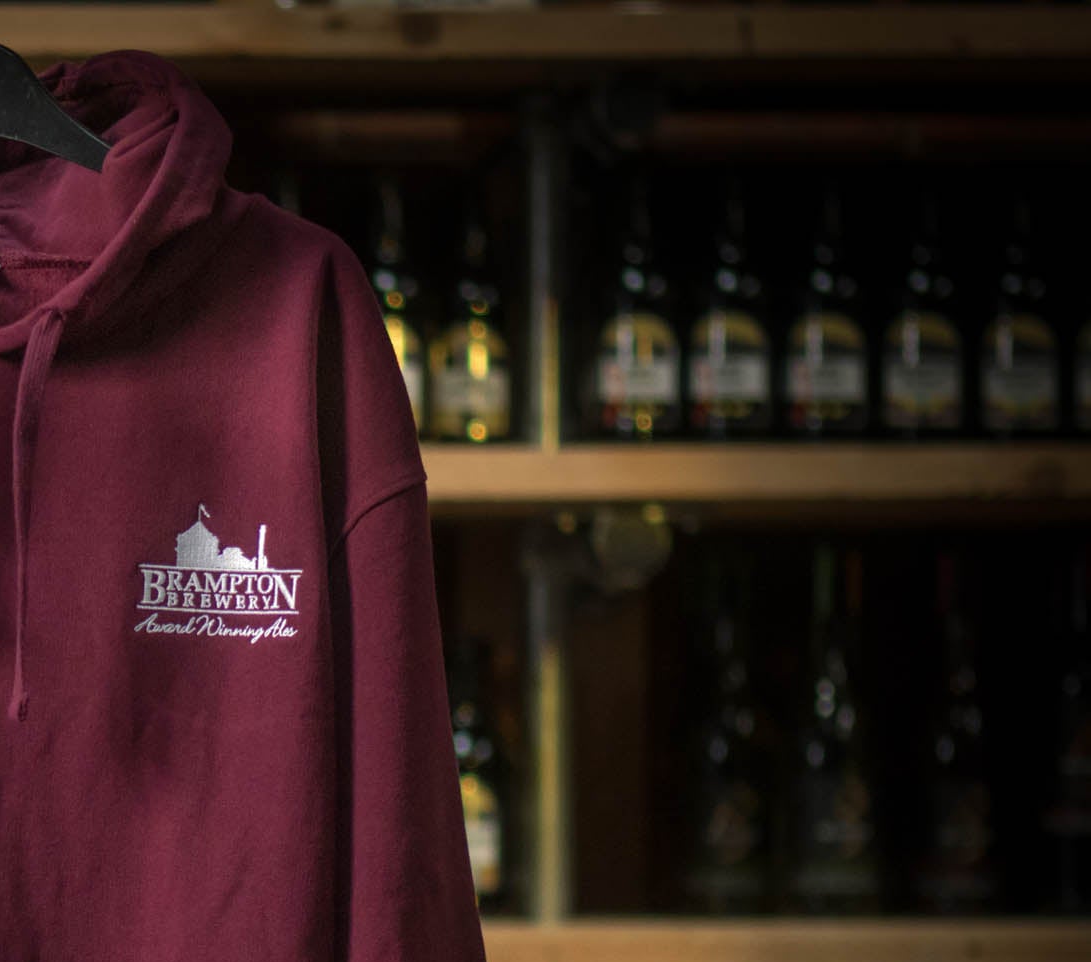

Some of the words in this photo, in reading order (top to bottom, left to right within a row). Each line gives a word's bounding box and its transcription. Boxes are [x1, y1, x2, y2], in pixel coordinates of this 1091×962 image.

[140, 569, 301, 609] BRAMPTON
[166, 592, 273, 610] BREWERY
[134, 613, 197, 633] Award
[196, 615, 264, 644] Winning
[262, 617, 298, 638] Ales
